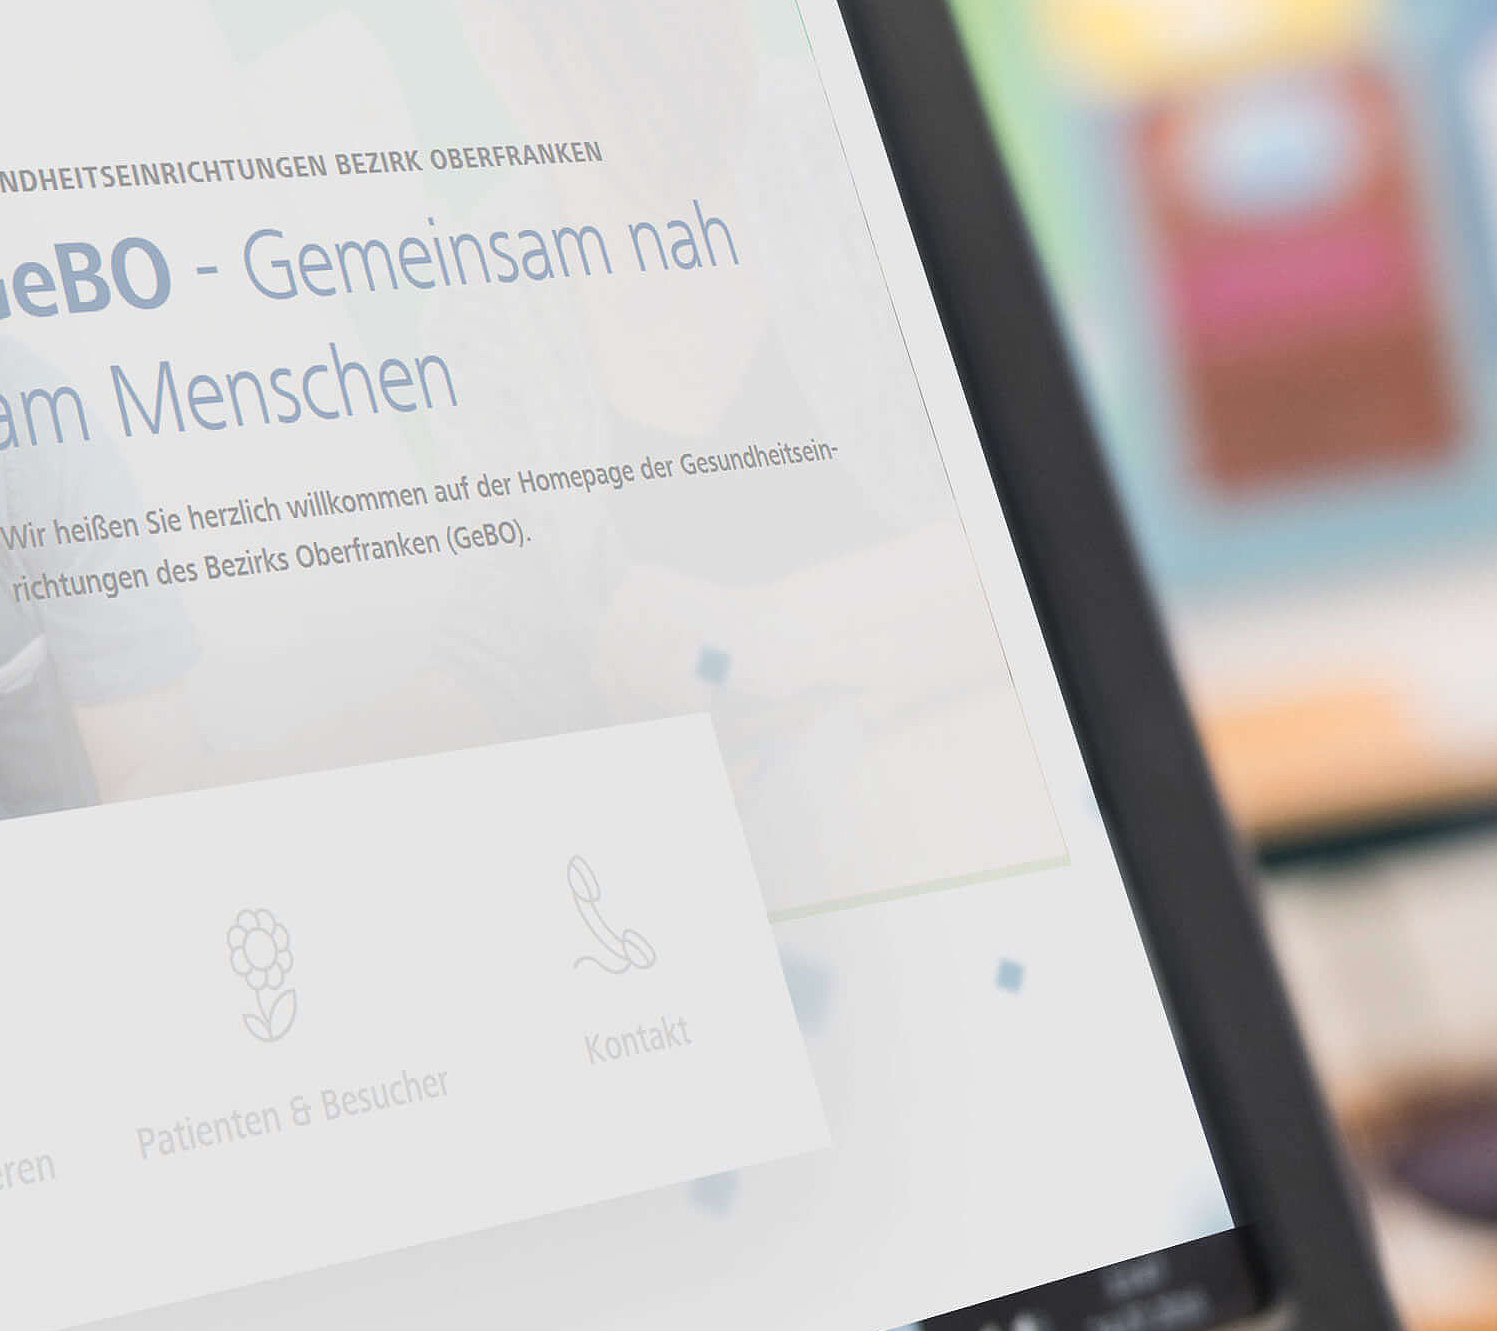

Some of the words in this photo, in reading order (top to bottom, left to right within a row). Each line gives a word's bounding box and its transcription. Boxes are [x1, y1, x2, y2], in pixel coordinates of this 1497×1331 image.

[334, 149, 424, 175] BEZIRK
[429, 141, 603, 170] OBERFRANKEN
[243, 216, 613, 301] Gemeinsam
[627, 198, 740, 272] nah
[109, 341, 458, 438] Menschen
[52, 514, 140, 545] heißen
[145, 507, 182, 535] Sie
[186, 496, 282, 530] herzlich
[285, 486, 429, 519] willkommen
[434, 475, 470, 503] auf
[476, 473, 511, 498] der
[517, 464, 635, 494] Homepage
[640, 455, 674, 480] der
[679, 438, 839, 476] Gesundheitsein-
[12, 568, 149, 605] richtungen
[155, 558, 199, 585] des
[203, 547, 290, 580] Bezirks
[295, 531, 442, 569] Oberfranken
[446, 518, 532, 556] (GeBO).
[583, 1015, 693, 1066] Kontakt
[136, 1106, 282, 1161] Patienten
[289, 1095, 312, 1127] &
[320, 1069, 448, 1121] Besucher
